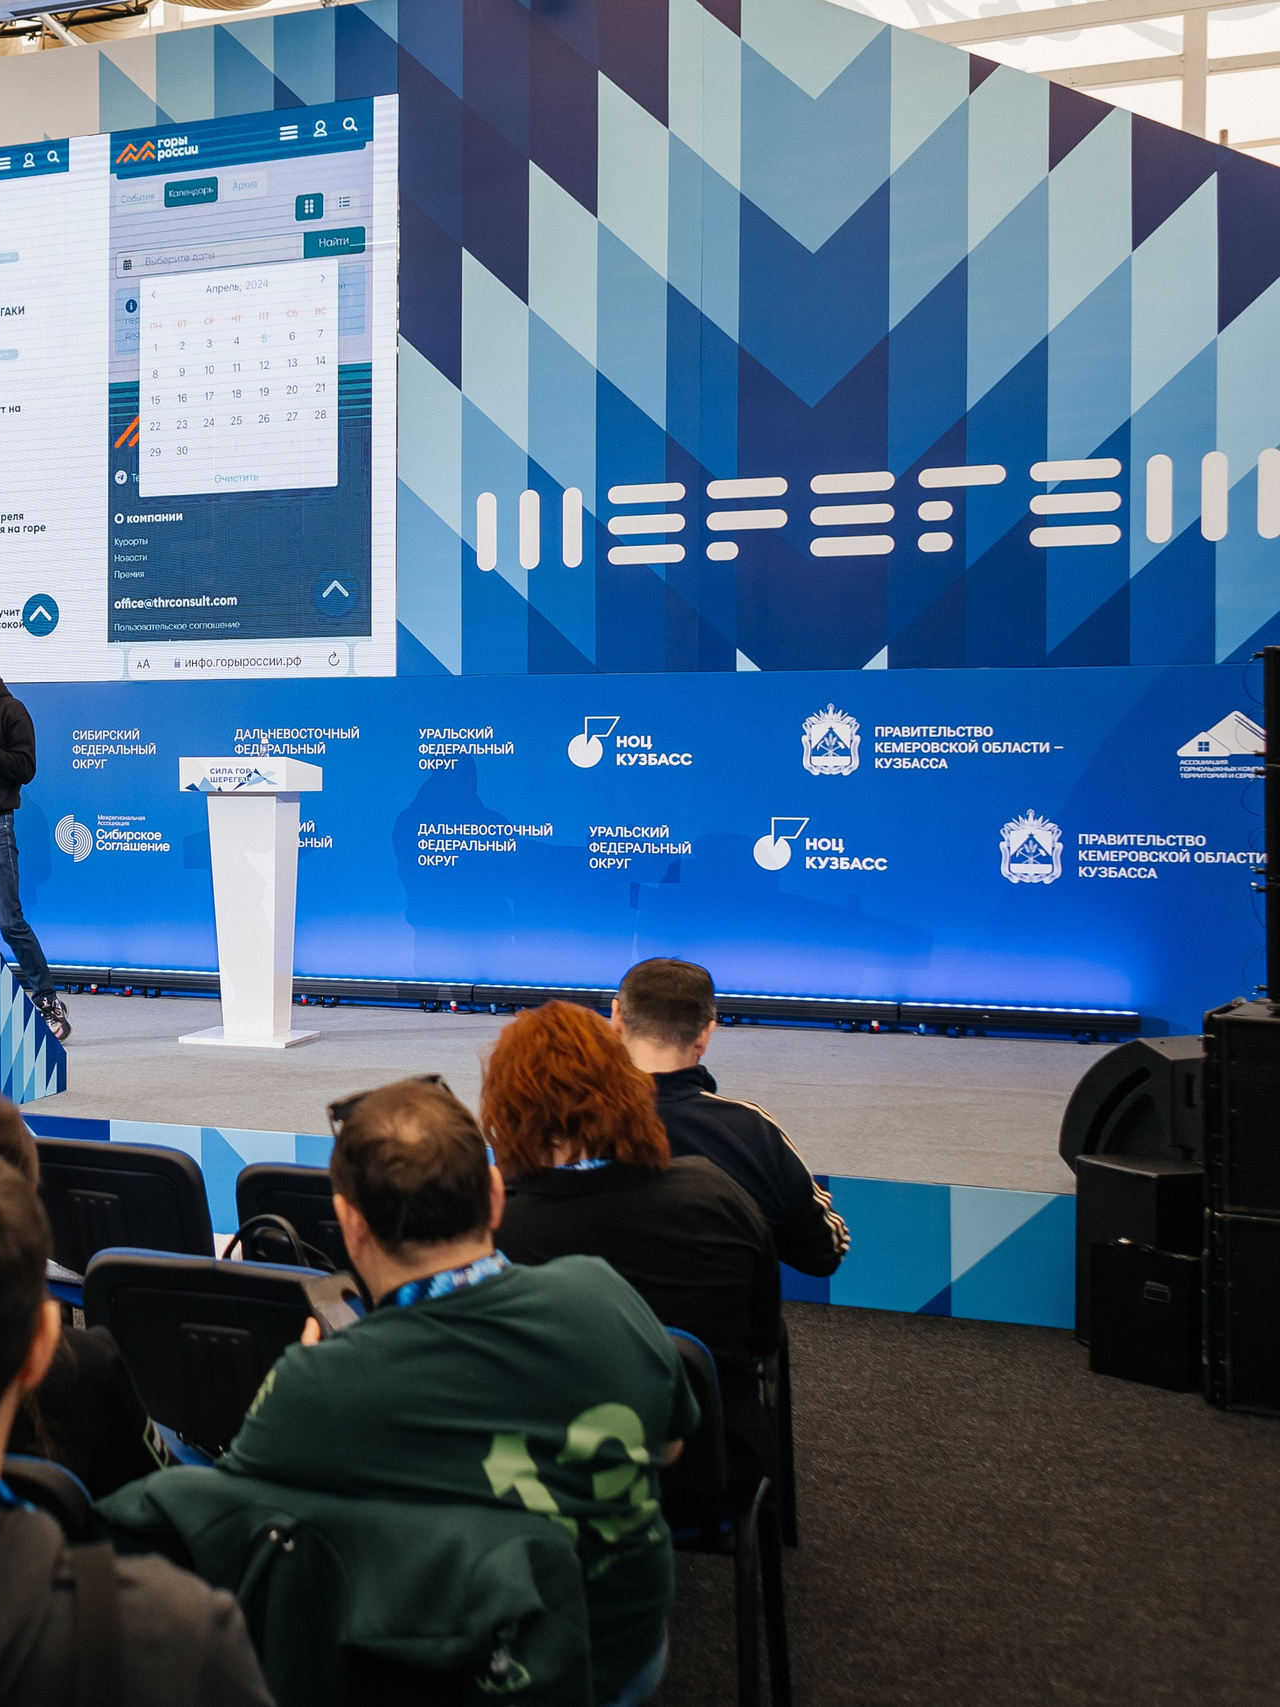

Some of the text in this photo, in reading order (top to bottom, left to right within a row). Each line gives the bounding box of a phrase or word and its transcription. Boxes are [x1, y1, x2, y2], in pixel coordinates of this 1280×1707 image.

[158, 136, 187, 149] горы
[158, 144, 198, 161] россии
[121, 180, 257, 204] События Календарь Архив
[319, 236, 349, 248] Найти
[145, 252, 215, 266] Выберите даты
[206, 279, 268, 294] Апрель, 2024
[204, 356, 326, 375] 10 11 12 13 14
[150, 383, 326, 405] 15 16 17 18 19 20 21
[9, 405, 21, 413] на
[215, 473, 258, 483] Очистить
[115, 512, 183, 523] О компании
[8, 525, 20, 533] на
[23, 523, 46, 533] горе
[115, 537, 148, 547] Курорты
[115, 553, 147, 562] Новости
[115, 570, 144, 580] Премия
[115, 595, 237, 609] office@thrconsult.com
[115, 620, 240, 632] Пользовательское соглашение
[185, 656, 301, 669] инфо.горыроссии.рф
[73, 728, 139, 740] СИБИРСКИЙ
[234, 726, 359, 741] ДАЛЬНЕВОСТОЧНЫЙ
[419, 726, 493, 739] УРАЛЬСКИЙ
[875, 726, 993, 738] ПРАВИТЕЛЬСТВО
[418, 742, 514, 756] ФЕДЕРАЛЬНЫЙ
[617, 736, 652, 749] НОЦ
[875, 739, 1049, 753] КЕМЕРОВСКОЙ ОБЛАСТИ
[73, 743, 156, 756] ФЕДЕРАЛЬНЫЙ
[73, 759, 107, 769] ОКРУГ
[419, 759, 458, 770] ОКРУГ
[617, 753, 692, 766] КУЗБАСС
[875, 758, 948, 769] КУЗБАССА
[98, 814, 145, 822] Межрегиональная
[96, 828, 161, 842] Сибирское
[418, 823, 553, 837] ДАЛЬНЕВОСТОЧНЫЙ
[589, 825, 669, 838] УРАЛЬСКИЙ
[96, 839, 170, 852] Соглашение
[418, 839, 517, 852] ФЕДЕРАЛЬНЫЙ
[805, 838, 844, 853] НОЦ
[1078, 834, 1206, 847] ПРАВИТЕЛЬСТВО
[589, 841, 691, 855] ФЕДЕРАЛЬНЫЙ
[418, 856, 458, 867] ОКРУГ
[1078, 849, 1268, 864] КЕМЕРОВСКОЙ ОБЛАСТИ
[589, 858, 631, 869] ОКРУГ
[806, 857, 888, 871] КУЗБАСС
[1078, 866, 1158, 879] КУЗБАССА
